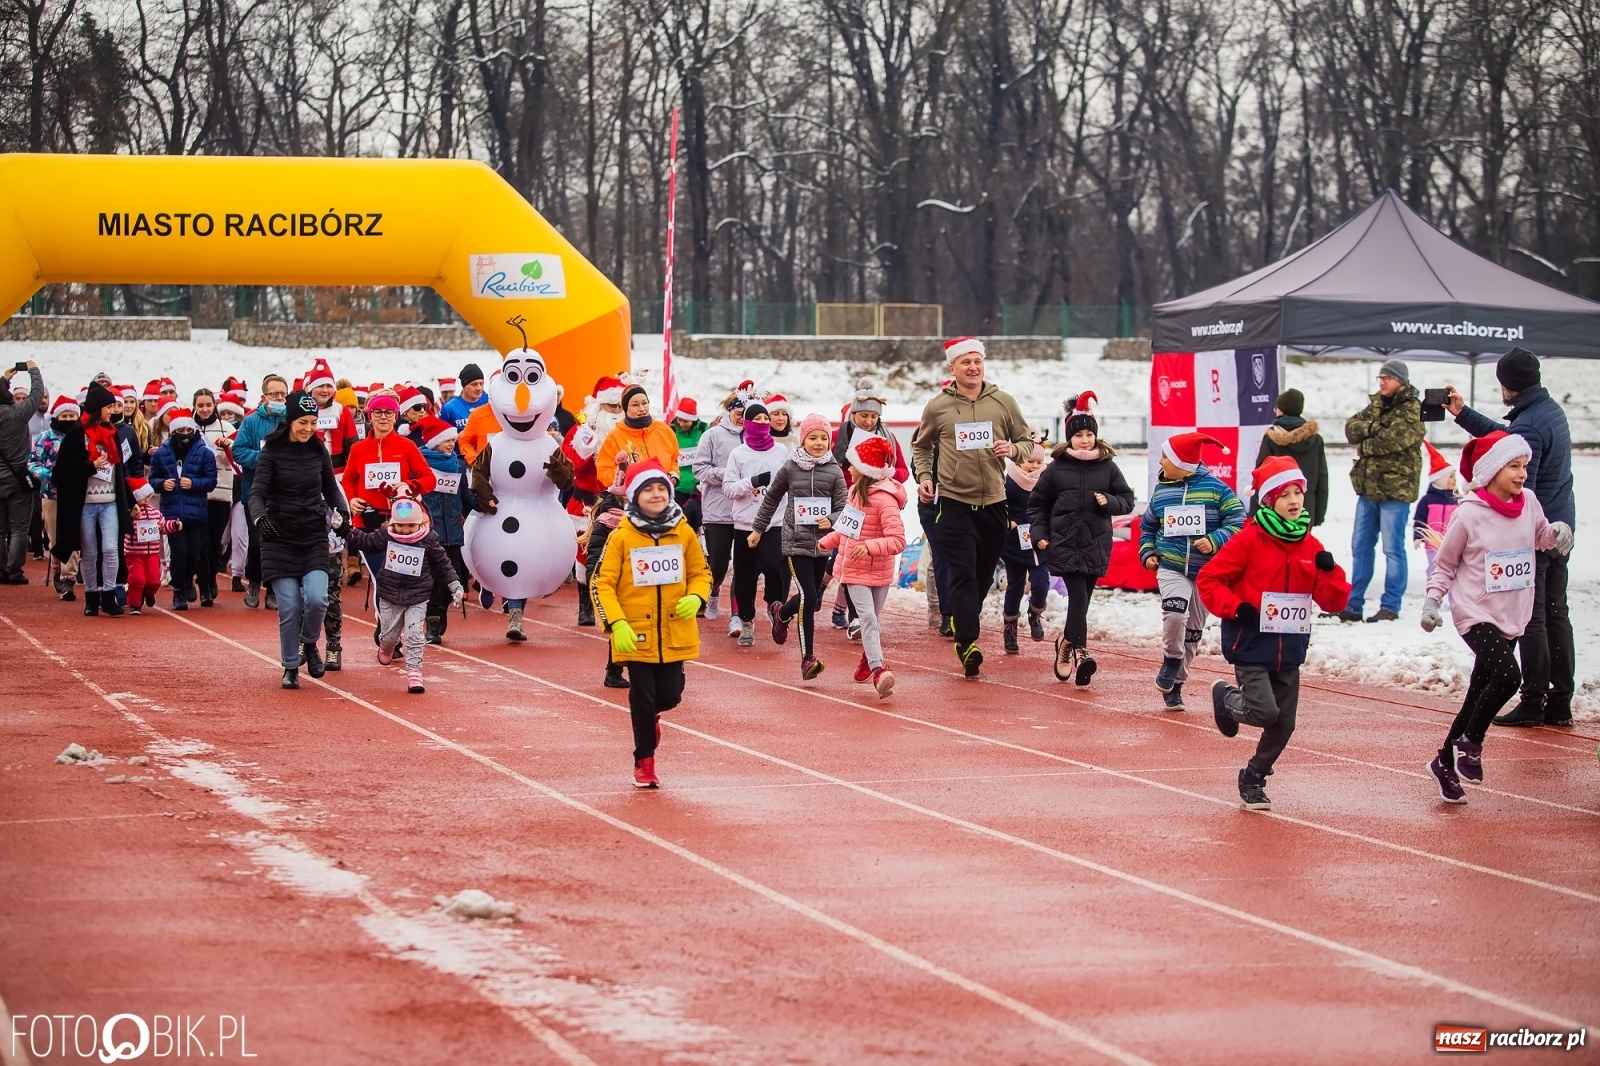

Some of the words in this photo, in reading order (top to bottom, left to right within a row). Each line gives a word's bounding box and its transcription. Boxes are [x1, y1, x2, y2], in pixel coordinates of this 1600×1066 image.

[98, 212, 214, 236] MIASTO
[225, 208, 383, 237] RACIBÓRZ
[1191, 320, 1244, 336] www.raciborz.pl
[1391, 320, 1524, 342] www.raciborz.pl
[968, 430, 990, 441] 030
[377, 471, 398, 481] 087
[437, 478, 457, 487] 022
[806, 506, 827, 516] 186
[841, 515, 859, 530] 079
[1177, 515, 1201, 527] 003
[397, 554, 419, 566] 009
[651, 558, 679, 573] 008
[1505, 561, 1531, 578] 082
[1280, 607, 1307, 621] 070
